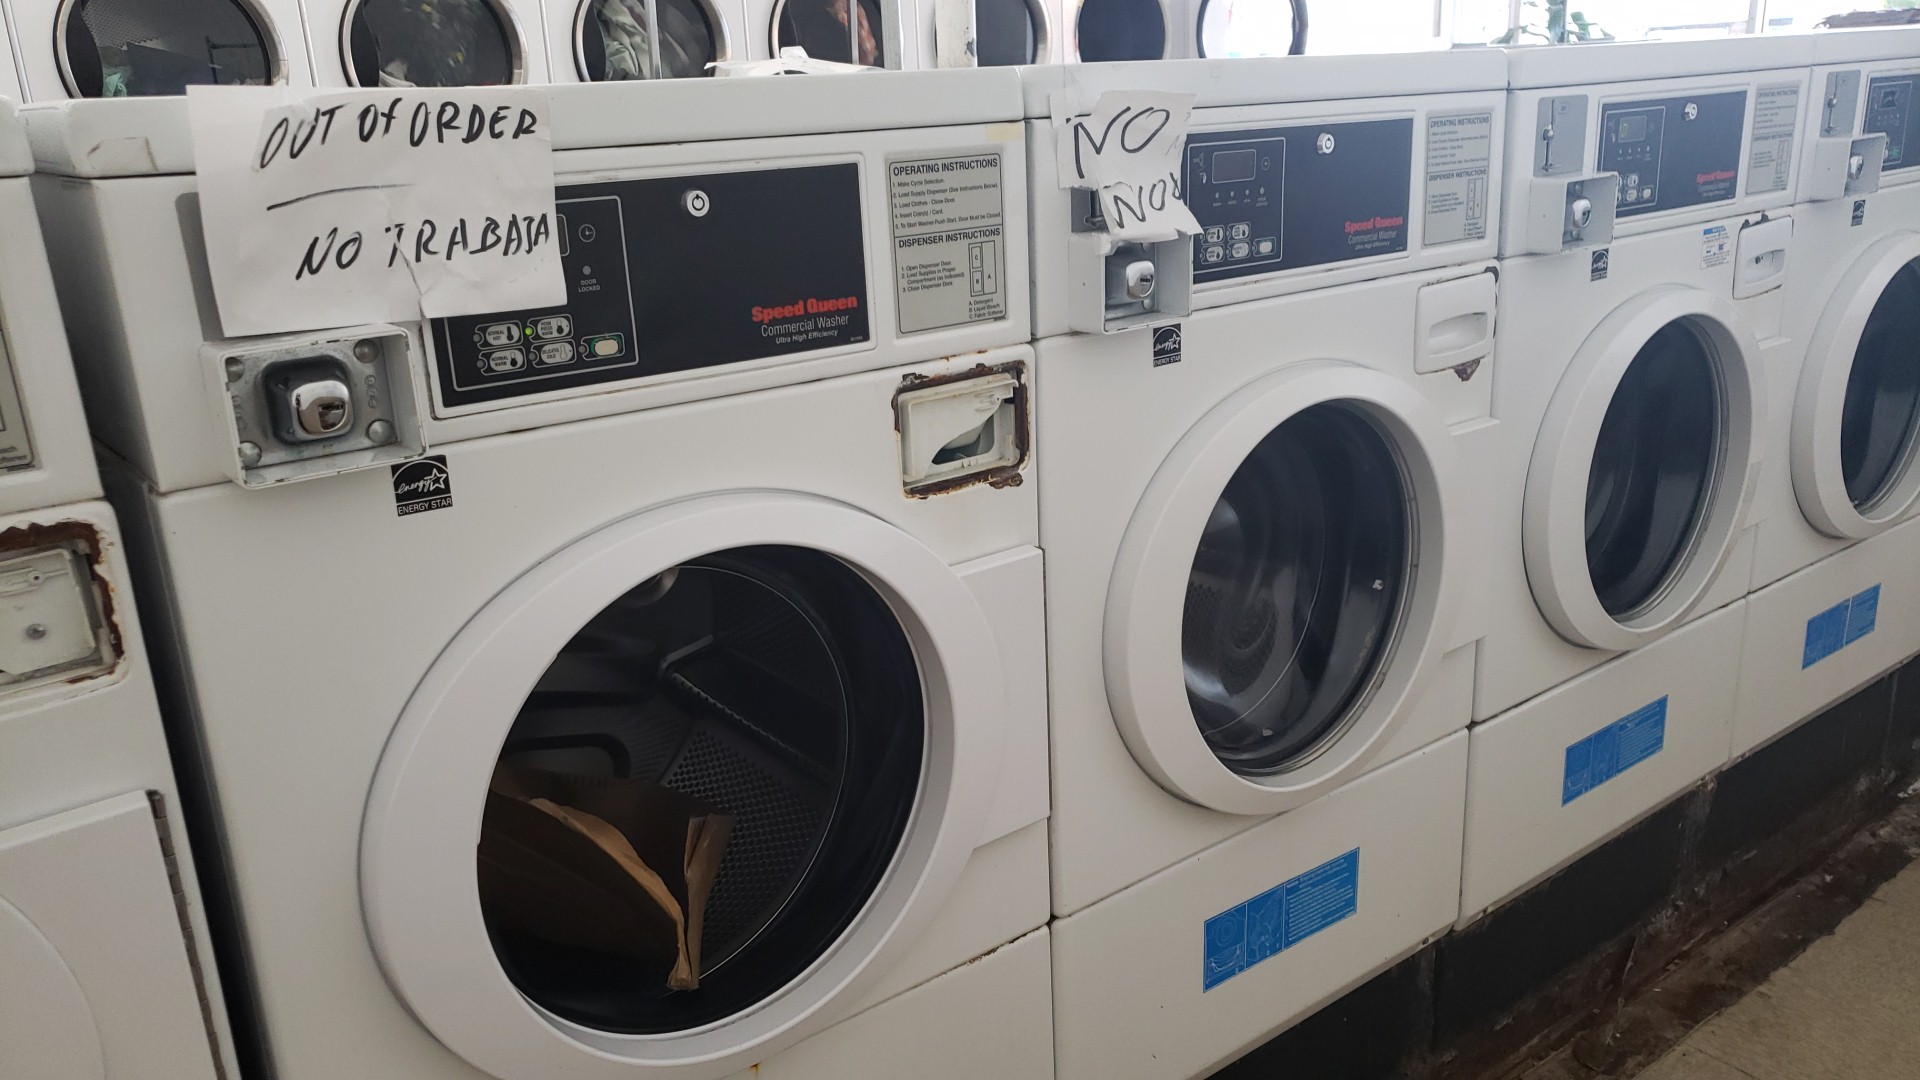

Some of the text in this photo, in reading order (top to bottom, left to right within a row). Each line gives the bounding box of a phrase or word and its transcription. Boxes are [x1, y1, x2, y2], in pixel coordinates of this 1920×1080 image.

[1430, 116, 1490, 128] OPERATING INSTRUCTIONS
[259, 102, 348, 169] OUT
[409, 101, 537, 148] ORDER
[1070, 106, 1171, 179] NO
[893, 158, 998, 176] OPERATING INSTRUCTIONS
[1429, 168, 1487, 182] DISPENSER INSTRUCTIONS
[926, 188, 948, 196] Dispenser
[1344, 216, 1403, 234] Speed Queen
[898, 228, 1001, 248] DISPENSER INSTRUCTIONS
[1348, 230, 1398, 244] Commercial Washer
[295, 226, 363, 281] NO
[921, 283, 942, 291] Dispenser
[751, 295, 858, 324] Speed Queen
[761, 315, 849, 337] Commercial Washer
[792, 333, 807, 343] High
[808, 329, 838, 339] Efficiency
[397, 477, 432, 494] energy
[398, 498, 452, 515] ENERGY STAR
